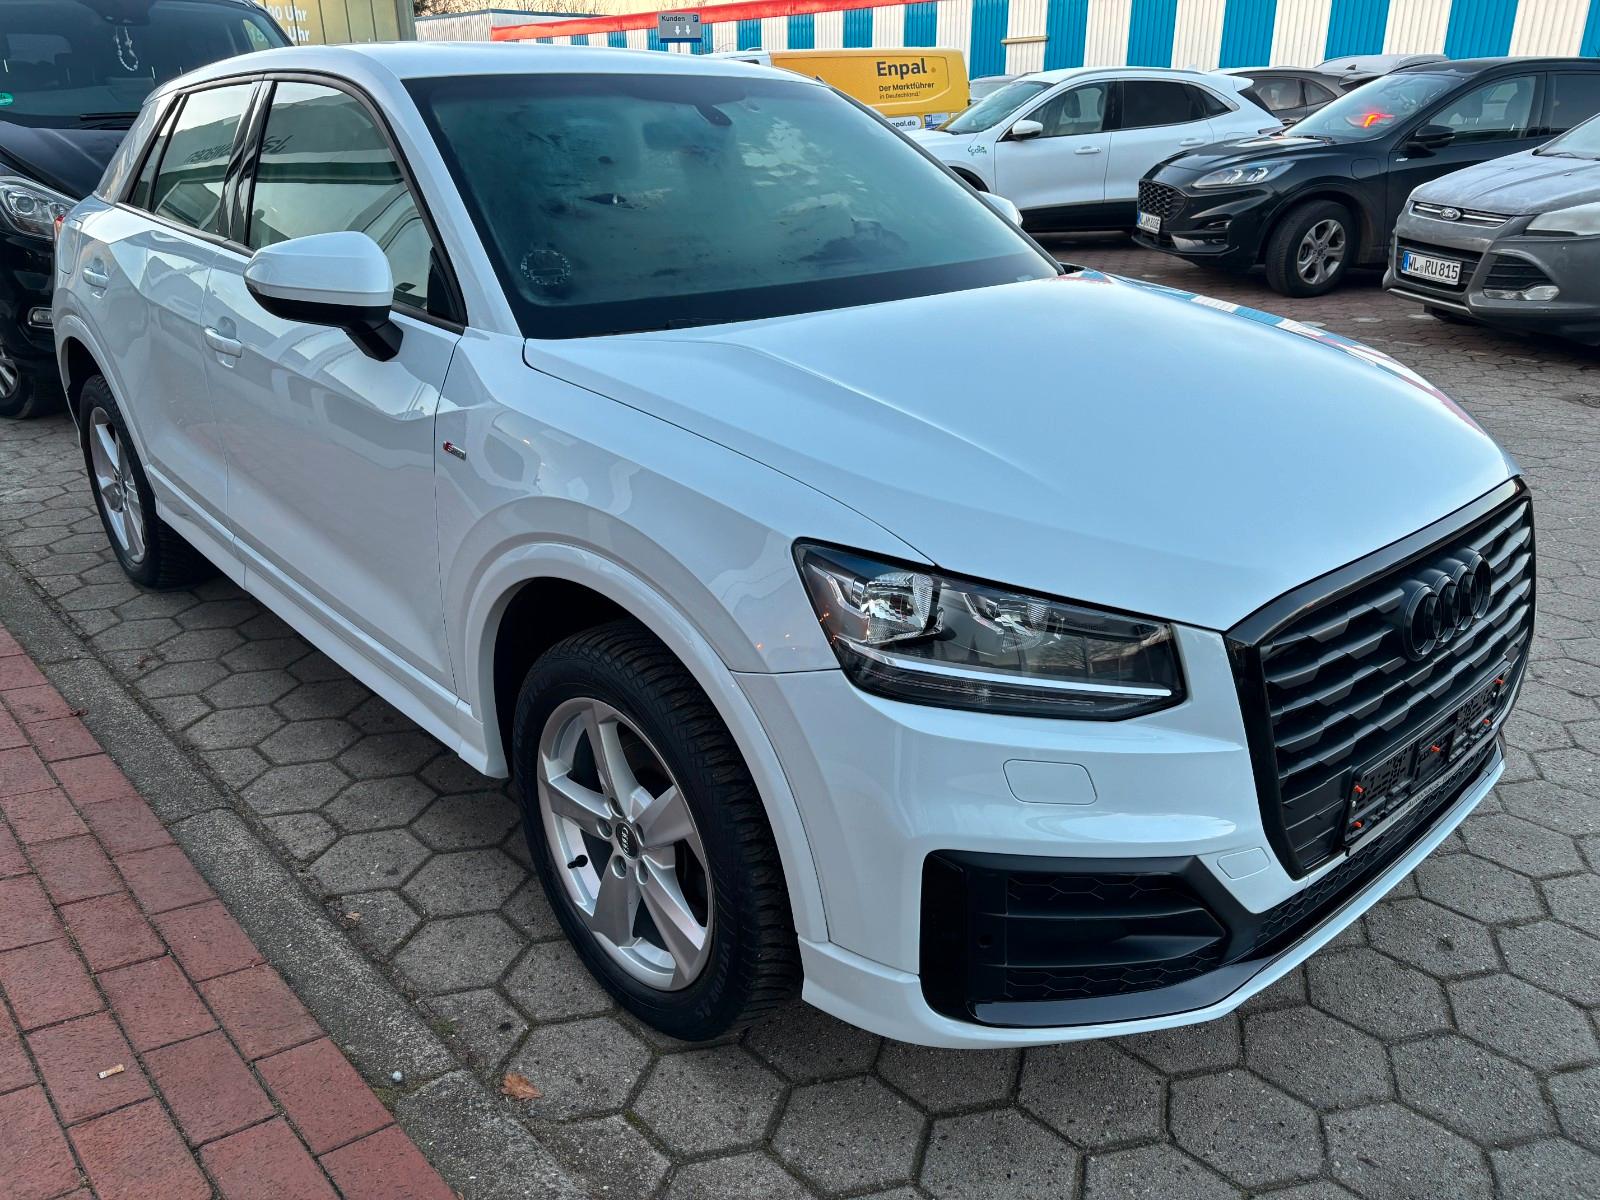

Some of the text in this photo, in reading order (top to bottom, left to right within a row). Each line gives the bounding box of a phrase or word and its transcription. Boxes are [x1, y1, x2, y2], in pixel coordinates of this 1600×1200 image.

[285, 5, 306, 21] Uhr
[287, 26, 309, 42] Uhr
[876, 58, 927, 80] Enpal
[892, 82, 935, 91] Marktführer
[1439, 262, 1459, 280] 815
